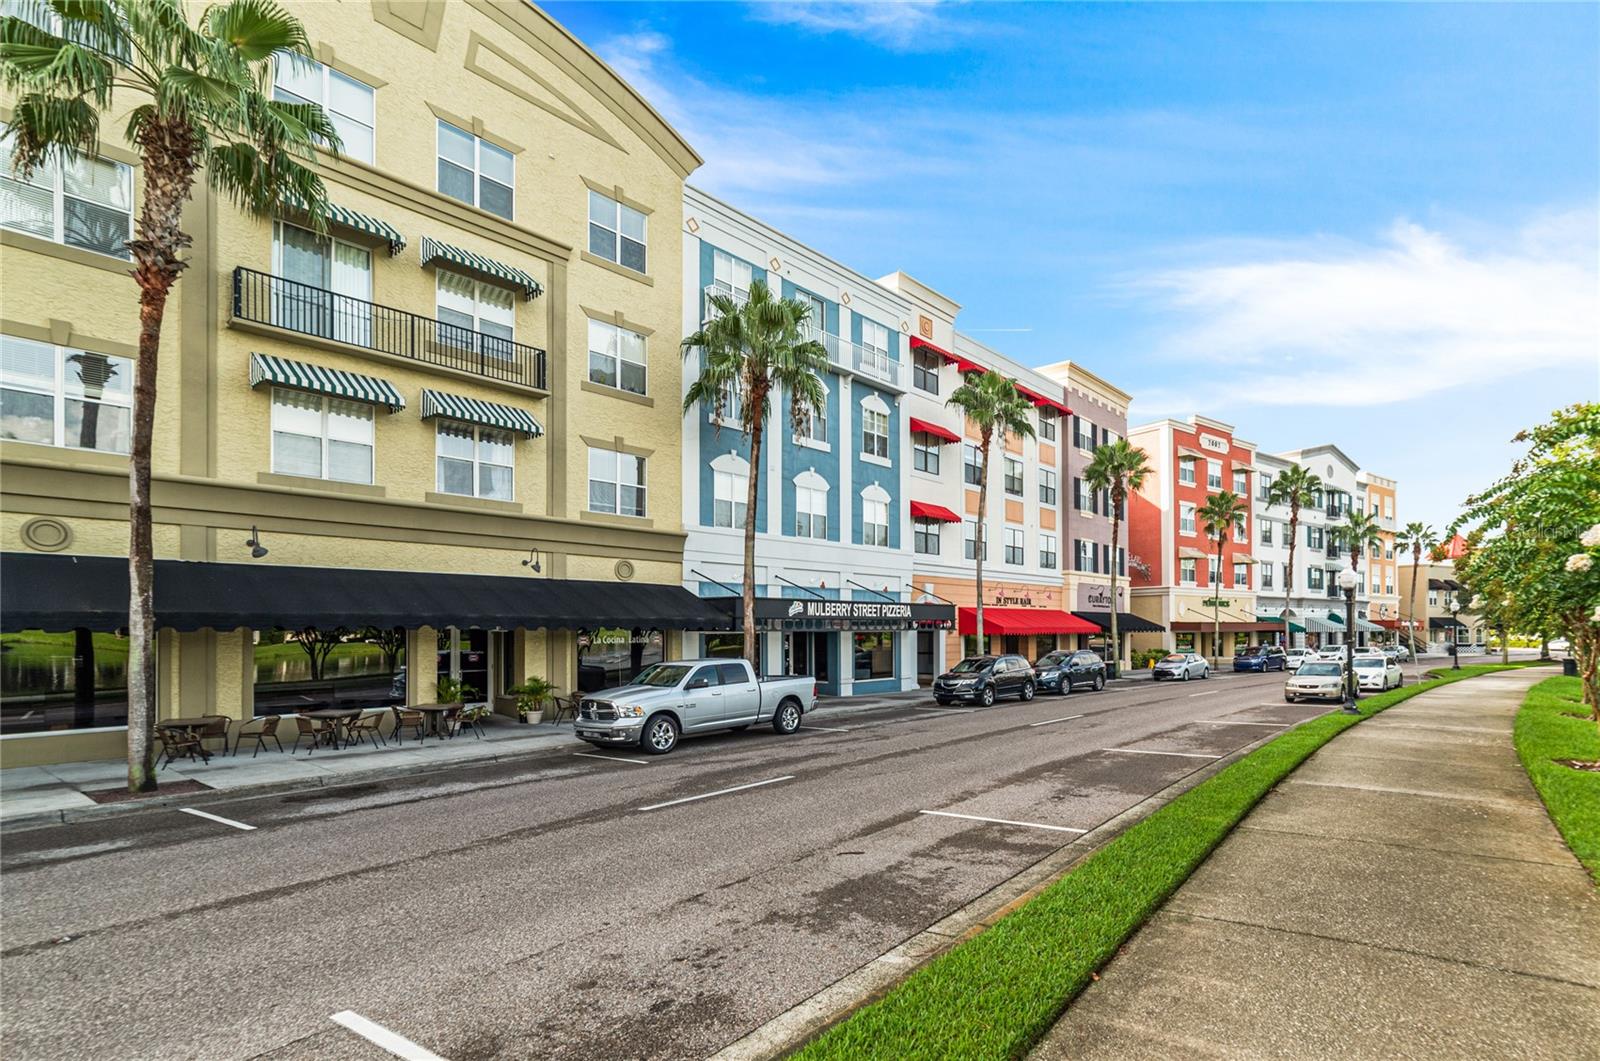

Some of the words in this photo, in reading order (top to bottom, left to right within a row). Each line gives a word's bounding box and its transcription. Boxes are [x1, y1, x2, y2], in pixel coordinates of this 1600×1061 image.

[1003, 597, 1019, 605] STYLE
[807, 601, 852, 617] MULBERRY
[853, 603, 881, 618] STREET
[882, 604, 912, 618] PIZZERIA
[593, 636, 601, 644] La
[603, 635, 624, 644] Cocina
[628, 636, 649, 644] Latina
